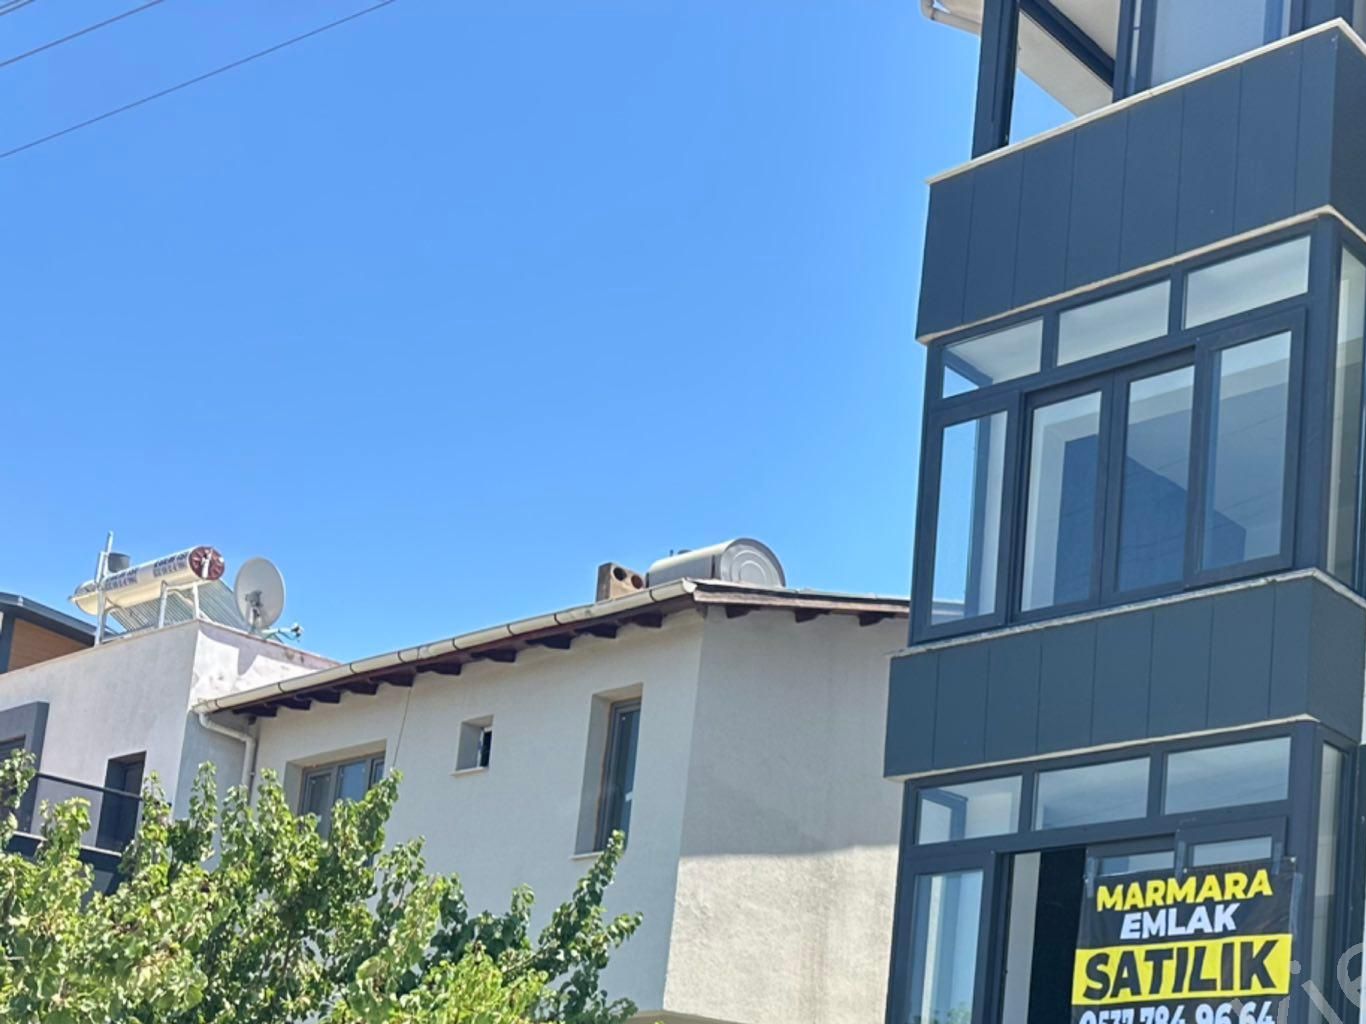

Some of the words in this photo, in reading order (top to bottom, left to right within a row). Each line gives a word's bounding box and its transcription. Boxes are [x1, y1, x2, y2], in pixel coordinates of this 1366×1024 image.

[1096, 868, 1273, 912] MARMARA
[1119, 902, 1241, 940] EMLAK
[1083, 940, 1279, 1000] SATILIK
